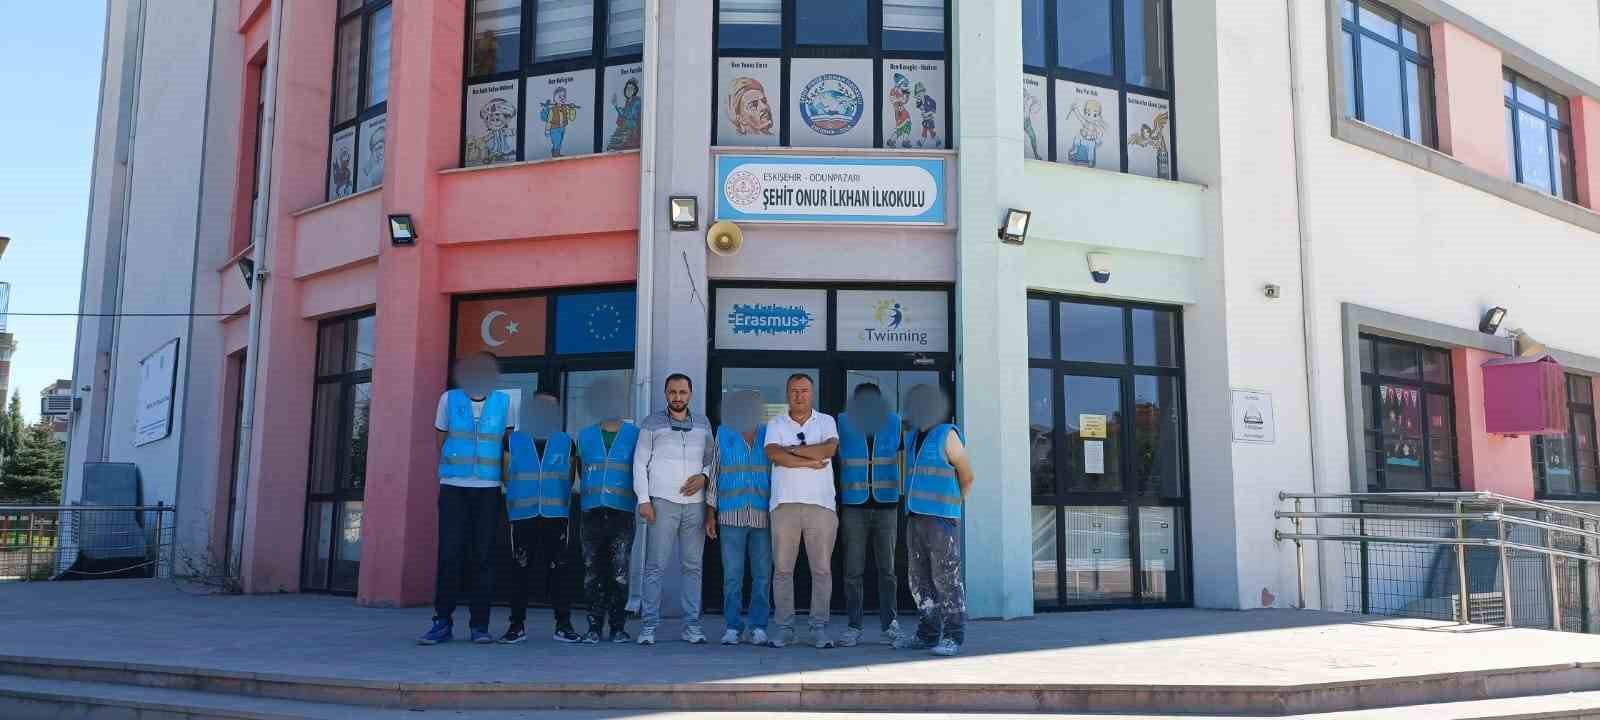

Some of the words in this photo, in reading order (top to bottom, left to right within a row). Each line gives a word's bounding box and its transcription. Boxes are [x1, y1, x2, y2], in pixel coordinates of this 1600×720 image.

[809, 173, 861, 183] ODUNPAZARI
[763, 185, 794, 210] ŞEHİT
[795, 188, 827, 206] ONUR
[829, 186, 871, 207] İLKHAN
[872, 186, 925, 208] İLKOKULU
[735, 313, 808, 328] Erasmus+
